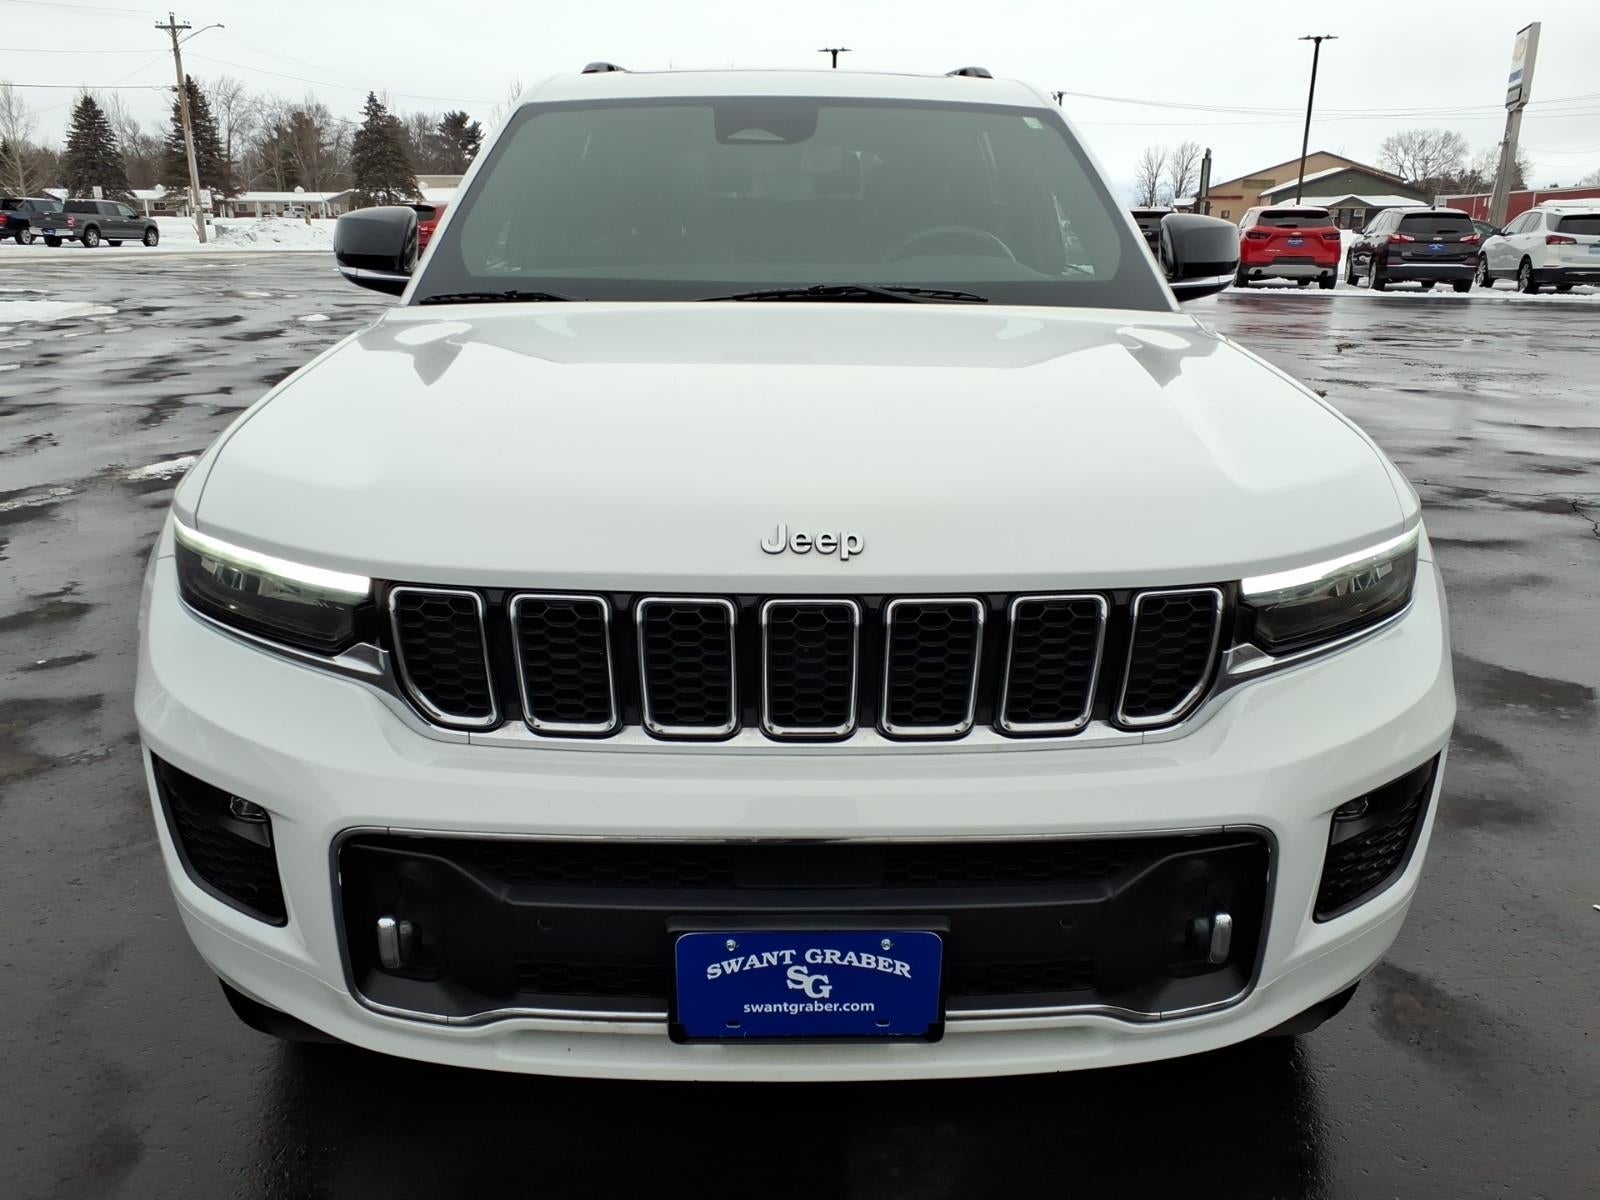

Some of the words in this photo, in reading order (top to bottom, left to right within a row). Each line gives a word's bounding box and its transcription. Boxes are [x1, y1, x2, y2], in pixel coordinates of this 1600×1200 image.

[761, 522, 864, 561] Jeep
[706, 949, 797, 980] SWANT
[804, 948, 912, 979] GRABER
[786, 965, 832, 999] SG
[743, 1001, 875, 1015] swantgraber.com
